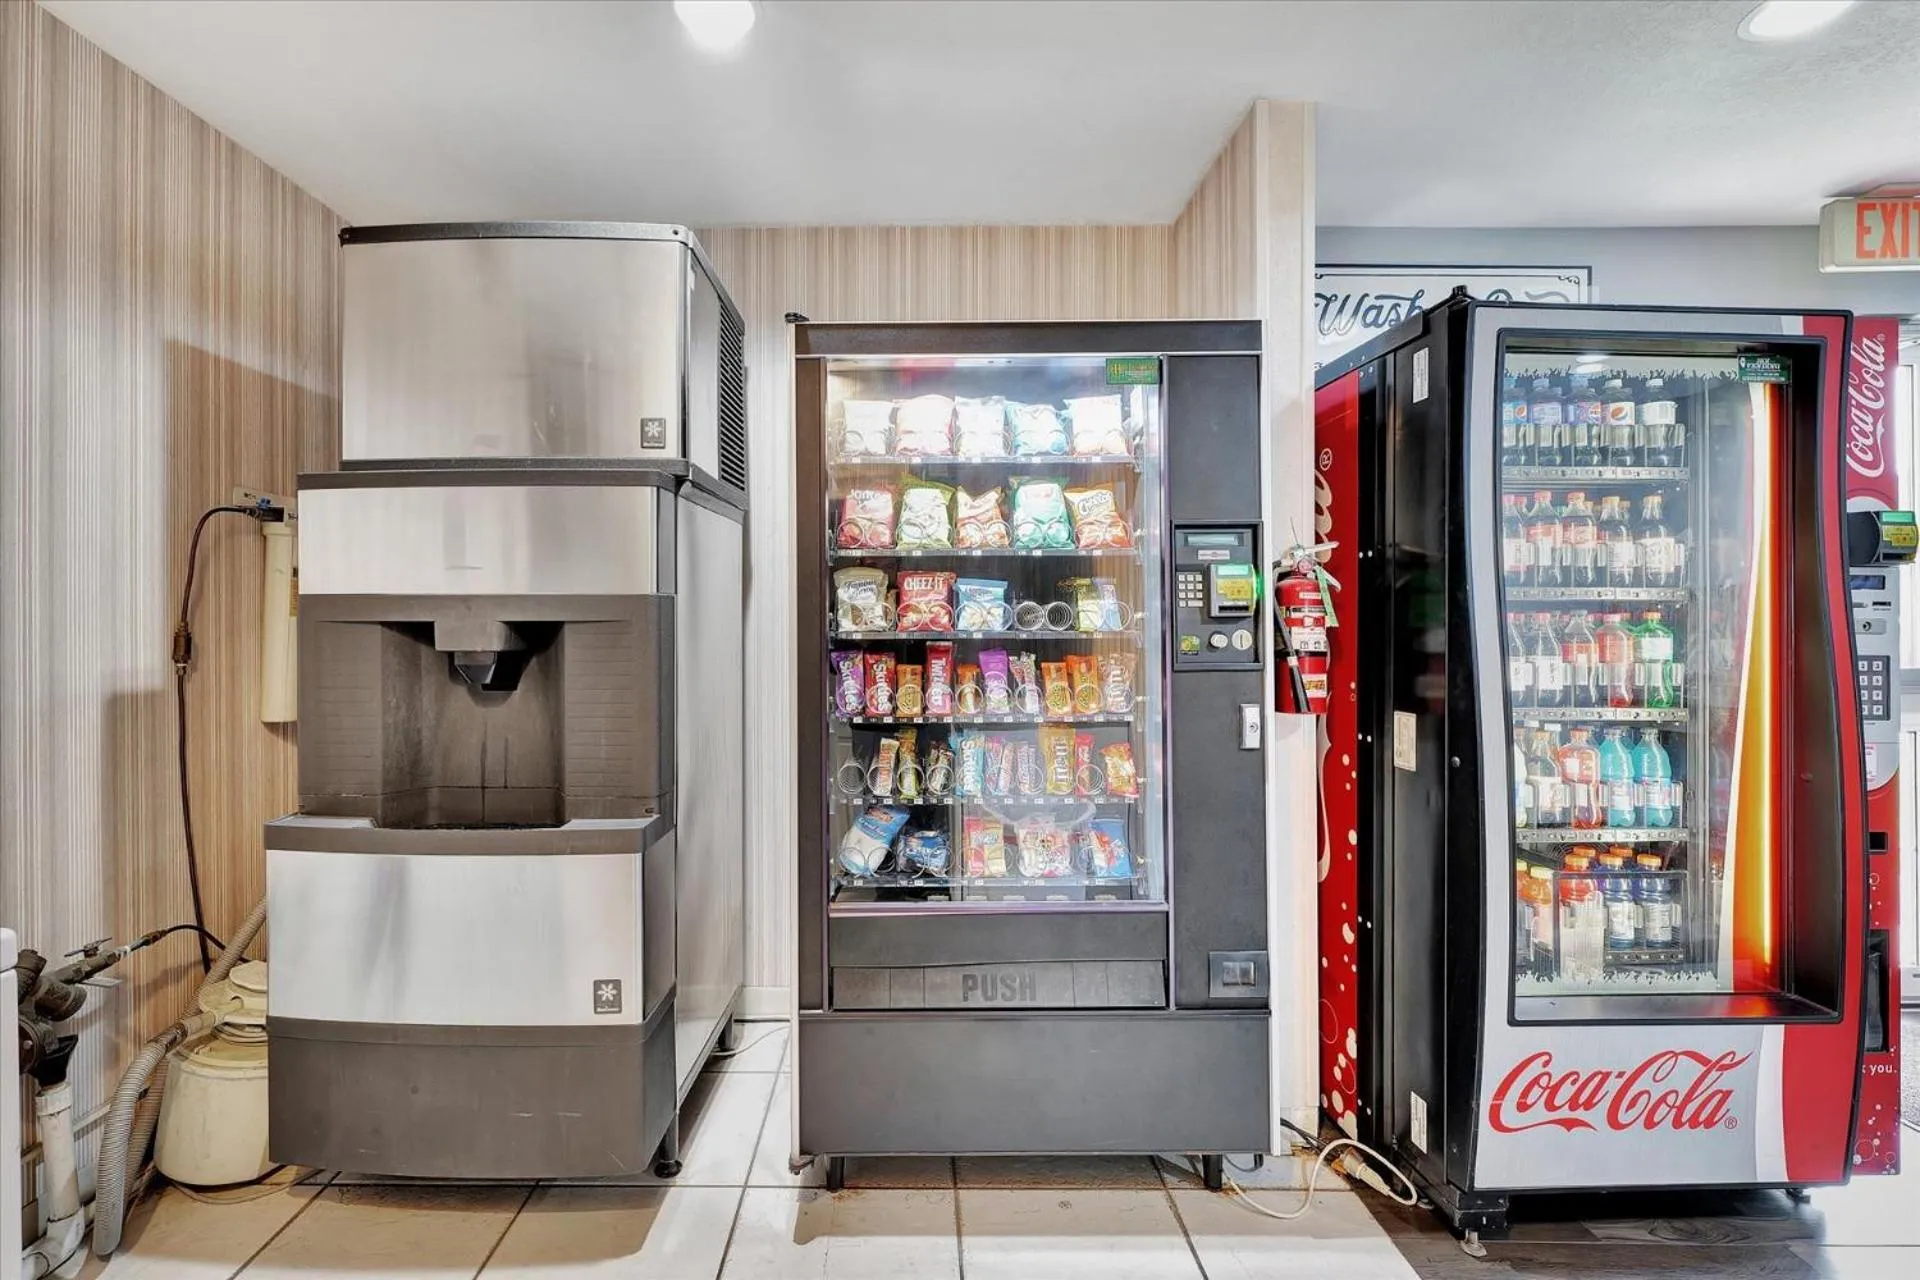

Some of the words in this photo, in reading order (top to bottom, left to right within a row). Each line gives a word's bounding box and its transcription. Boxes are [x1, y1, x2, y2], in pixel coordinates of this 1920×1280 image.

[962, 972, 1037, 1002] PUSH
[1869, 1064, 1898, 1076] you.
[1489, 1050, 1753, 1133] Coca-Cola
